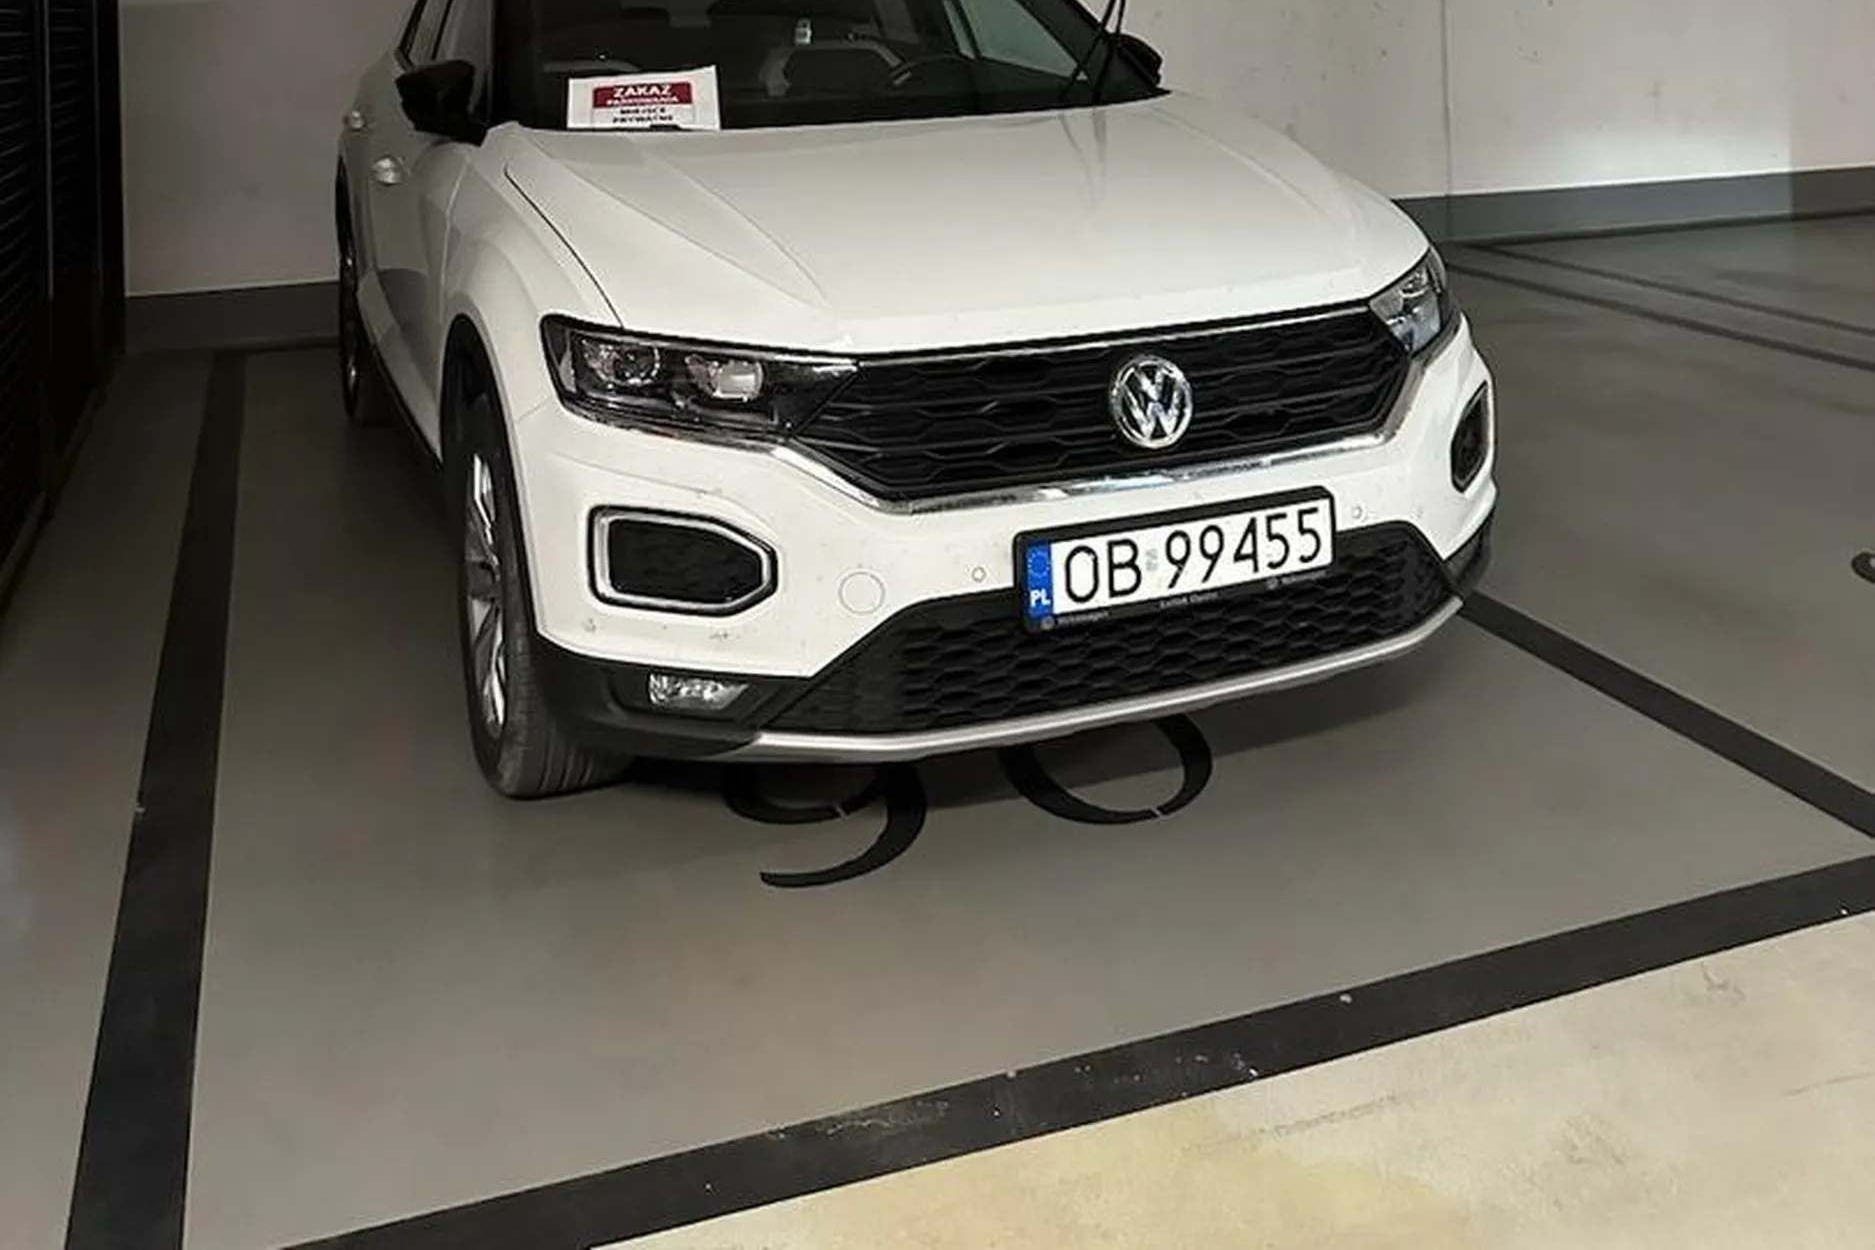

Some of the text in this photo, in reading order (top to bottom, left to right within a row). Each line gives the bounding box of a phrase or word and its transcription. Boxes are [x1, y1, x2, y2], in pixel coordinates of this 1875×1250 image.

[612, 84, 673, 98] ZAKAZ
[1065, 506, 1322, 603] OB 99455
[1029, 589, 1051, 608] PL
